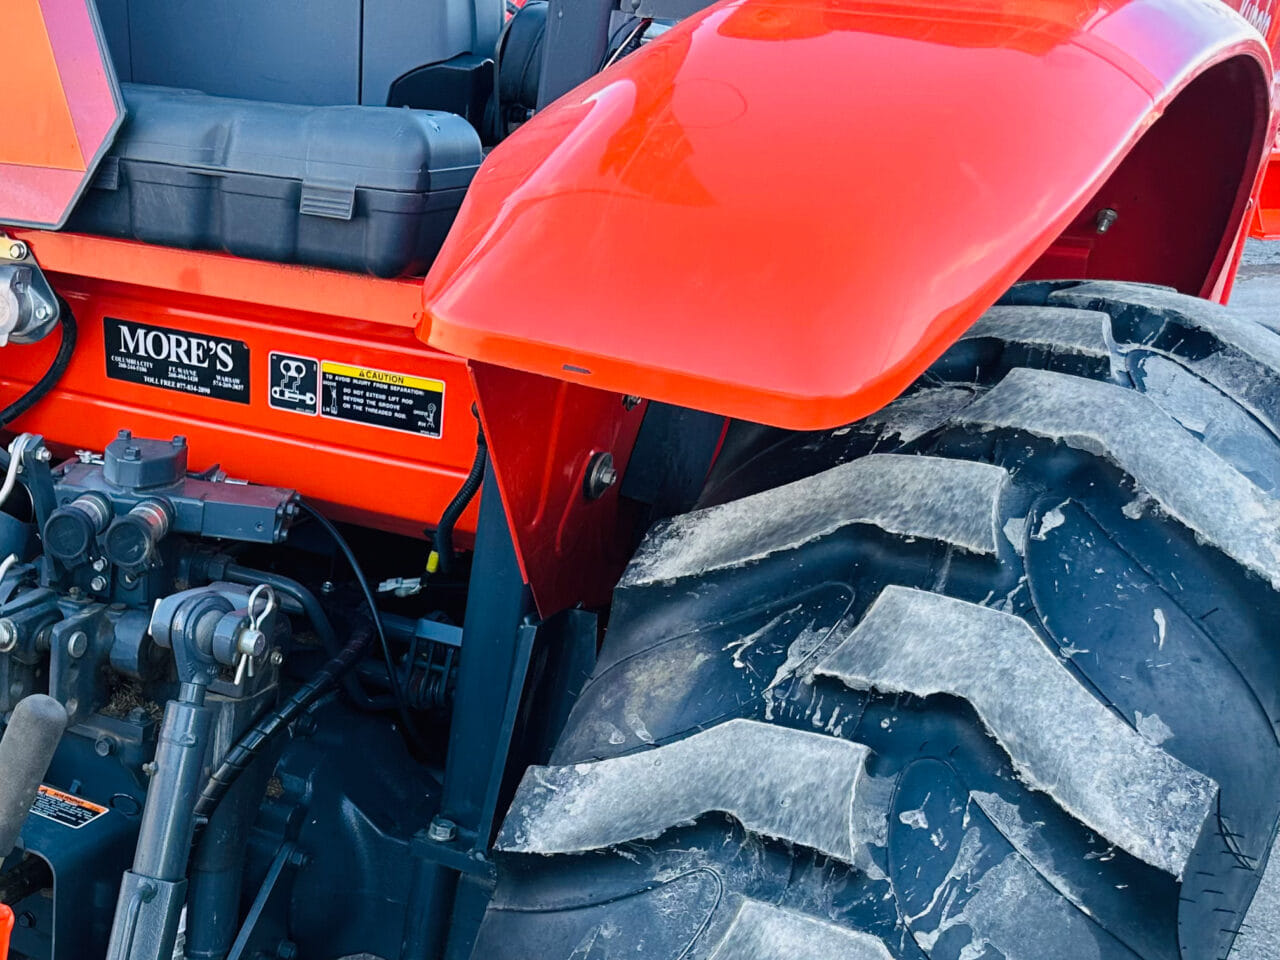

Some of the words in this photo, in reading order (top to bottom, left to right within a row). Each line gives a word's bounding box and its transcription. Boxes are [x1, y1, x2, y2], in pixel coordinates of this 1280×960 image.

[118, 325, 234, 372] MORE'S
[143, 376, 160, 385] TOLL
[160, 379, 176, 388] FREE
[335, 375, 351, 383] AVOID
[352, 378, 371, 386] INJURY
[373, 381, 388, 390] FROM
[365, 370, 404, 384] CAUTION
[365, 391, 387, 400] EXTEND
[343, 395, 365, 404] BEYOND
[378, 401, 401, 411] GROOVE
[365, 406, 393, 417] THREADED
